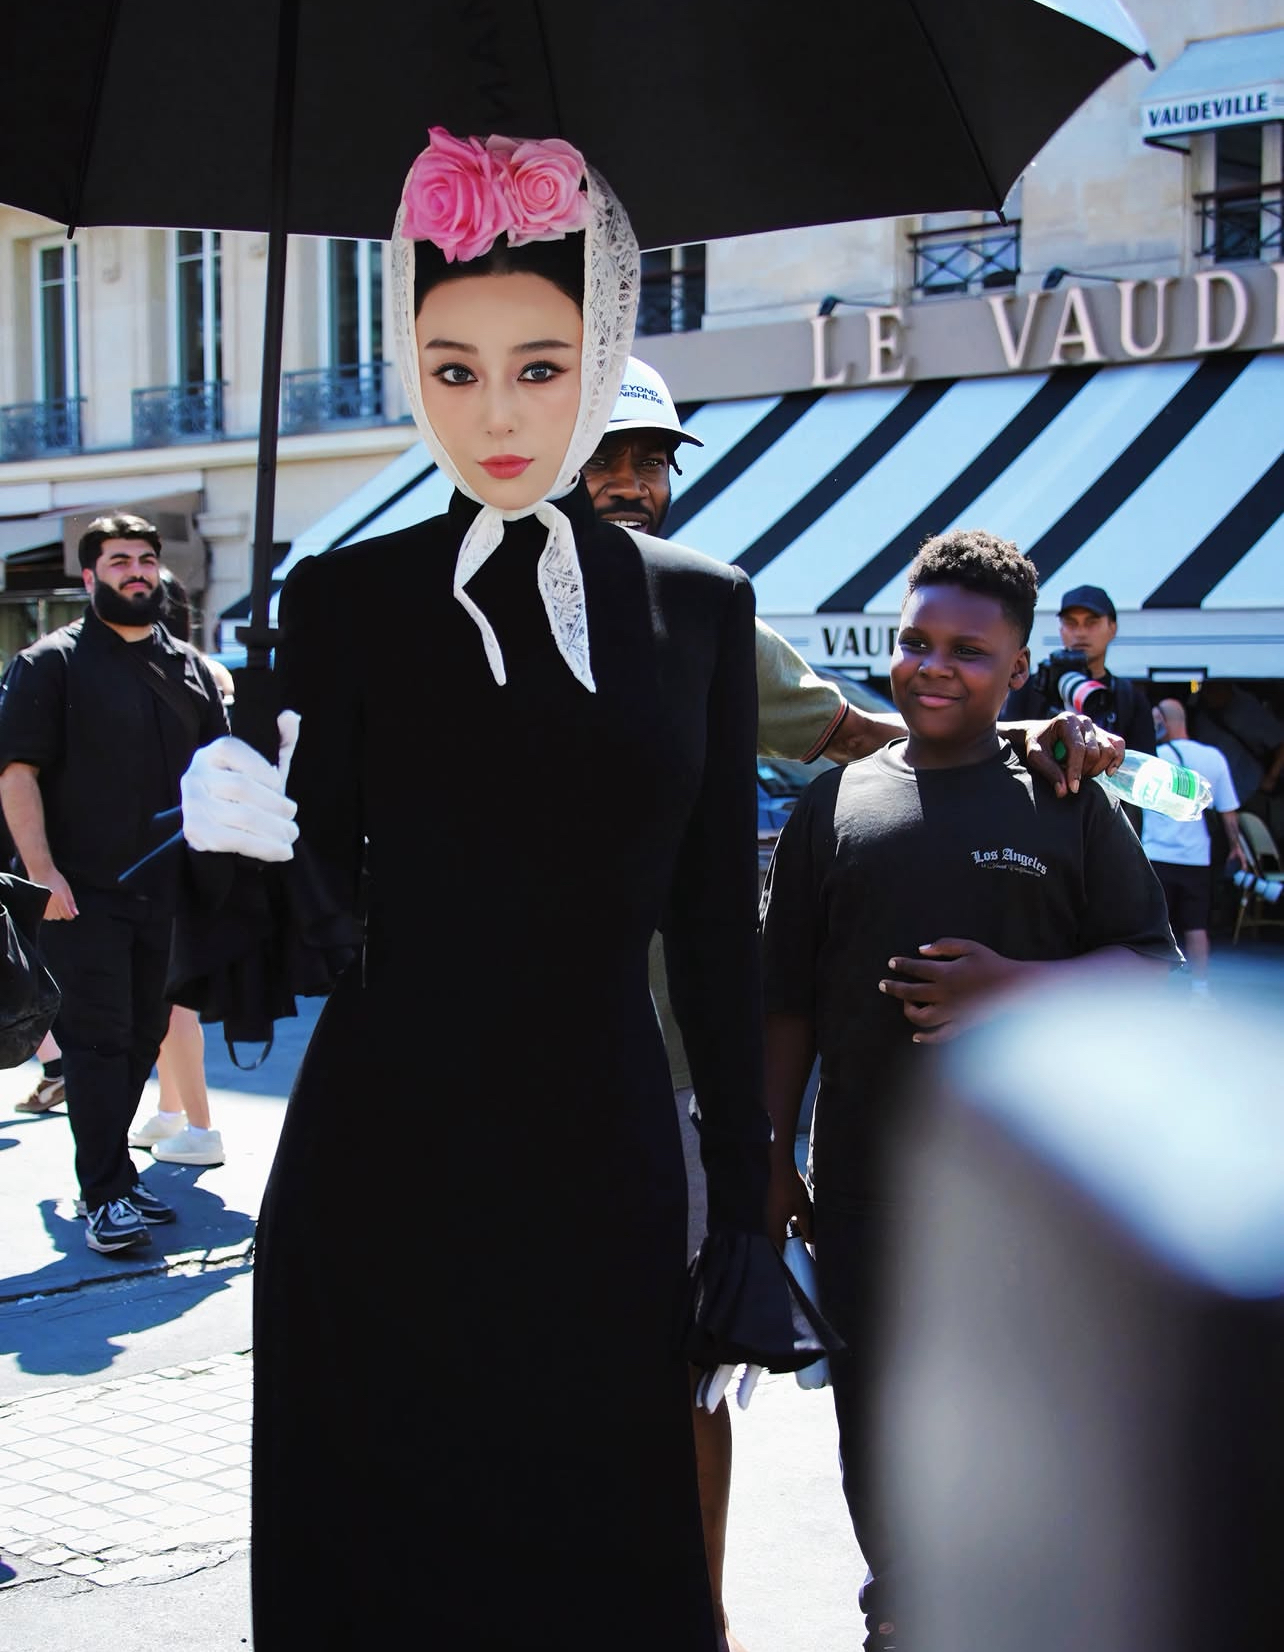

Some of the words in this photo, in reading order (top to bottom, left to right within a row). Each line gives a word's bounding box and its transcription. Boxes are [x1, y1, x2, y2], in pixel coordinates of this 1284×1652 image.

[1149, 92, 1268, 127] VAUDEVILLE
[810, 306, 905, 386] LE
[971, 850, 998, 864] Los
[1002, 847, 1048, 875] Angeles
